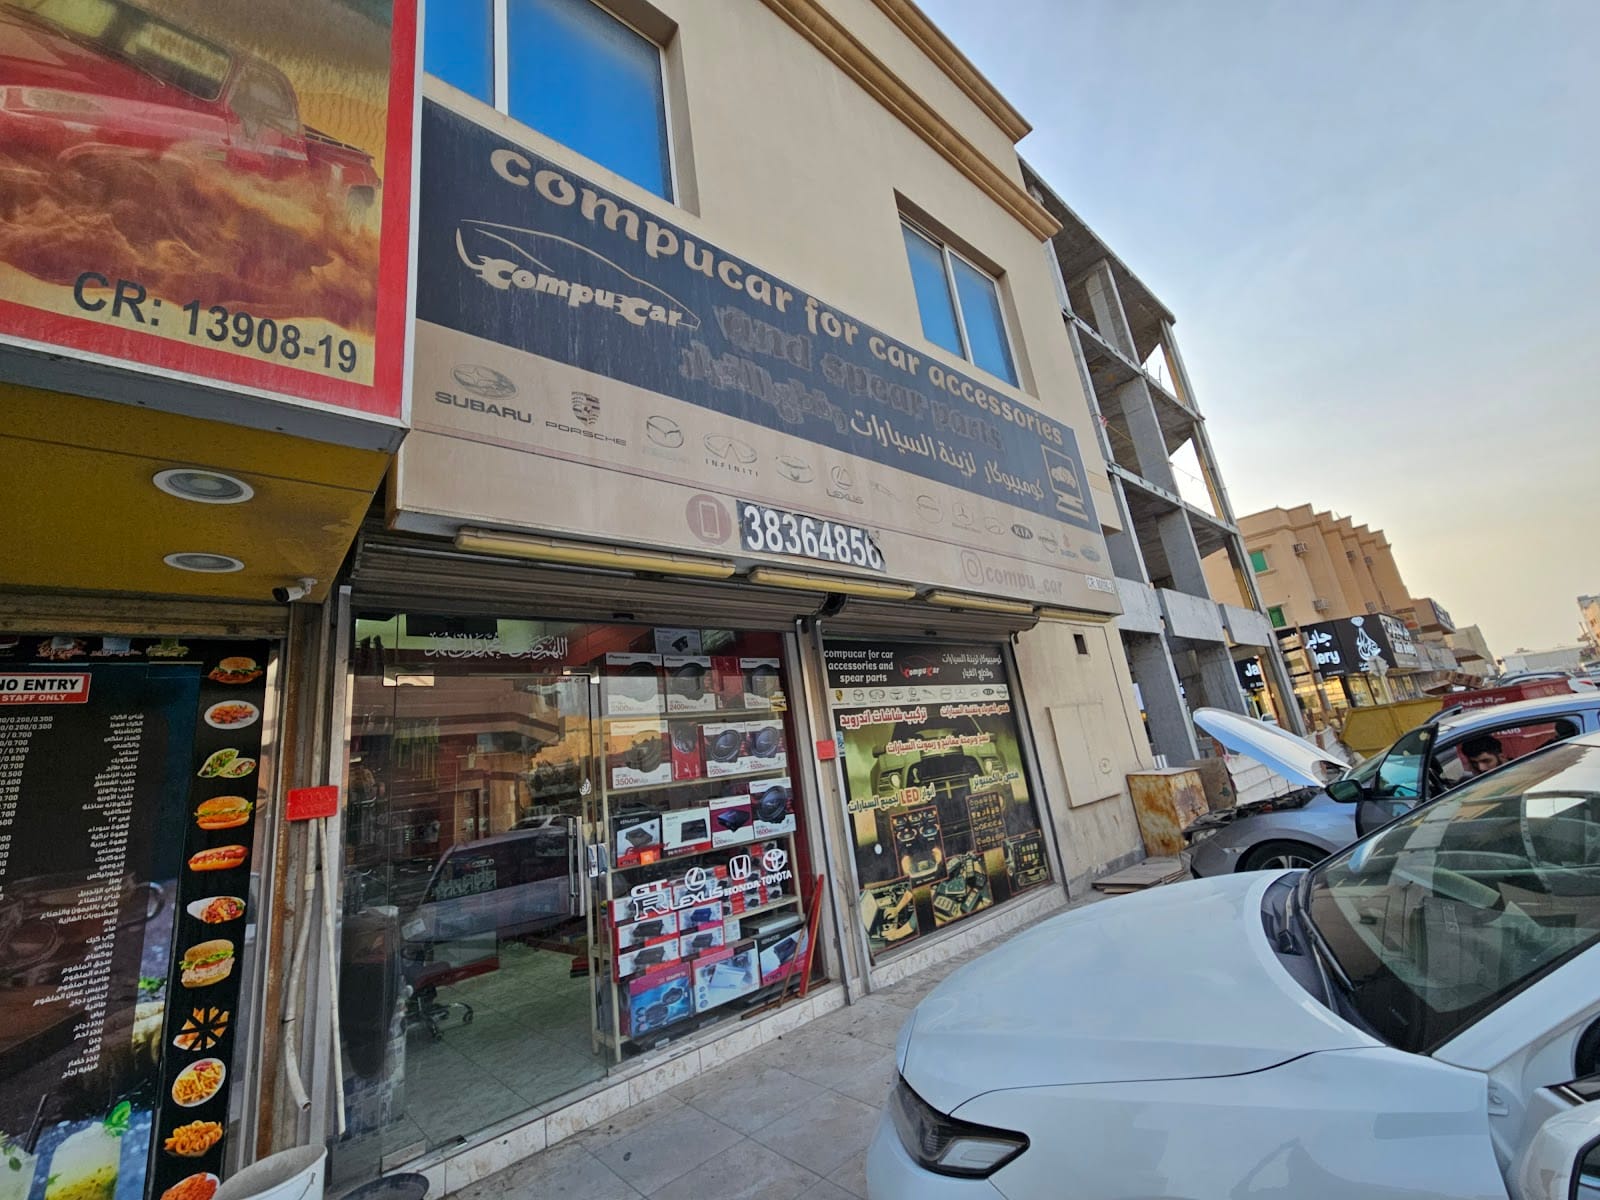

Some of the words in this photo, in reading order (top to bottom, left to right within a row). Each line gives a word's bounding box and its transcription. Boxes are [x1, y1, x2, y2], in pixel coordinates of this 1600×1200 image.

[490, 149, 793, 313] compucar
[804, 297, 859, 347] for
[868, 334, 920, 376] car
[928, 367, 1062, 446] accessories
[73, 272, 161, 327] CR:
[182, 299, 358, 373] 13908-19
[434, 390, 532, 424] SUBARU
[545, 420, 627, 447] PORSCHE
[850, 408, 938, 462] السيارات
[704, 457, 760, 478] INFINITI
[824, 649, 866, 660] compucar
[868, 649, 880, 660] for
[881, 651, 894, 659] car
[828, 660, 877, 671] accessories
[879, 661, 894, 670] and
[23, 678, 80, 691] ENTRY
[840, 674, 864, 684] spear
[865, 673, 888, 683] parts
[2, 694, 36, 702] STAFF
[38, 693, 67, 701] ONLY
[901, 787, 920, 804] LED
[761, 870, 793, 887] TOYOTA
[723, 881, 761, 896] HONDA
